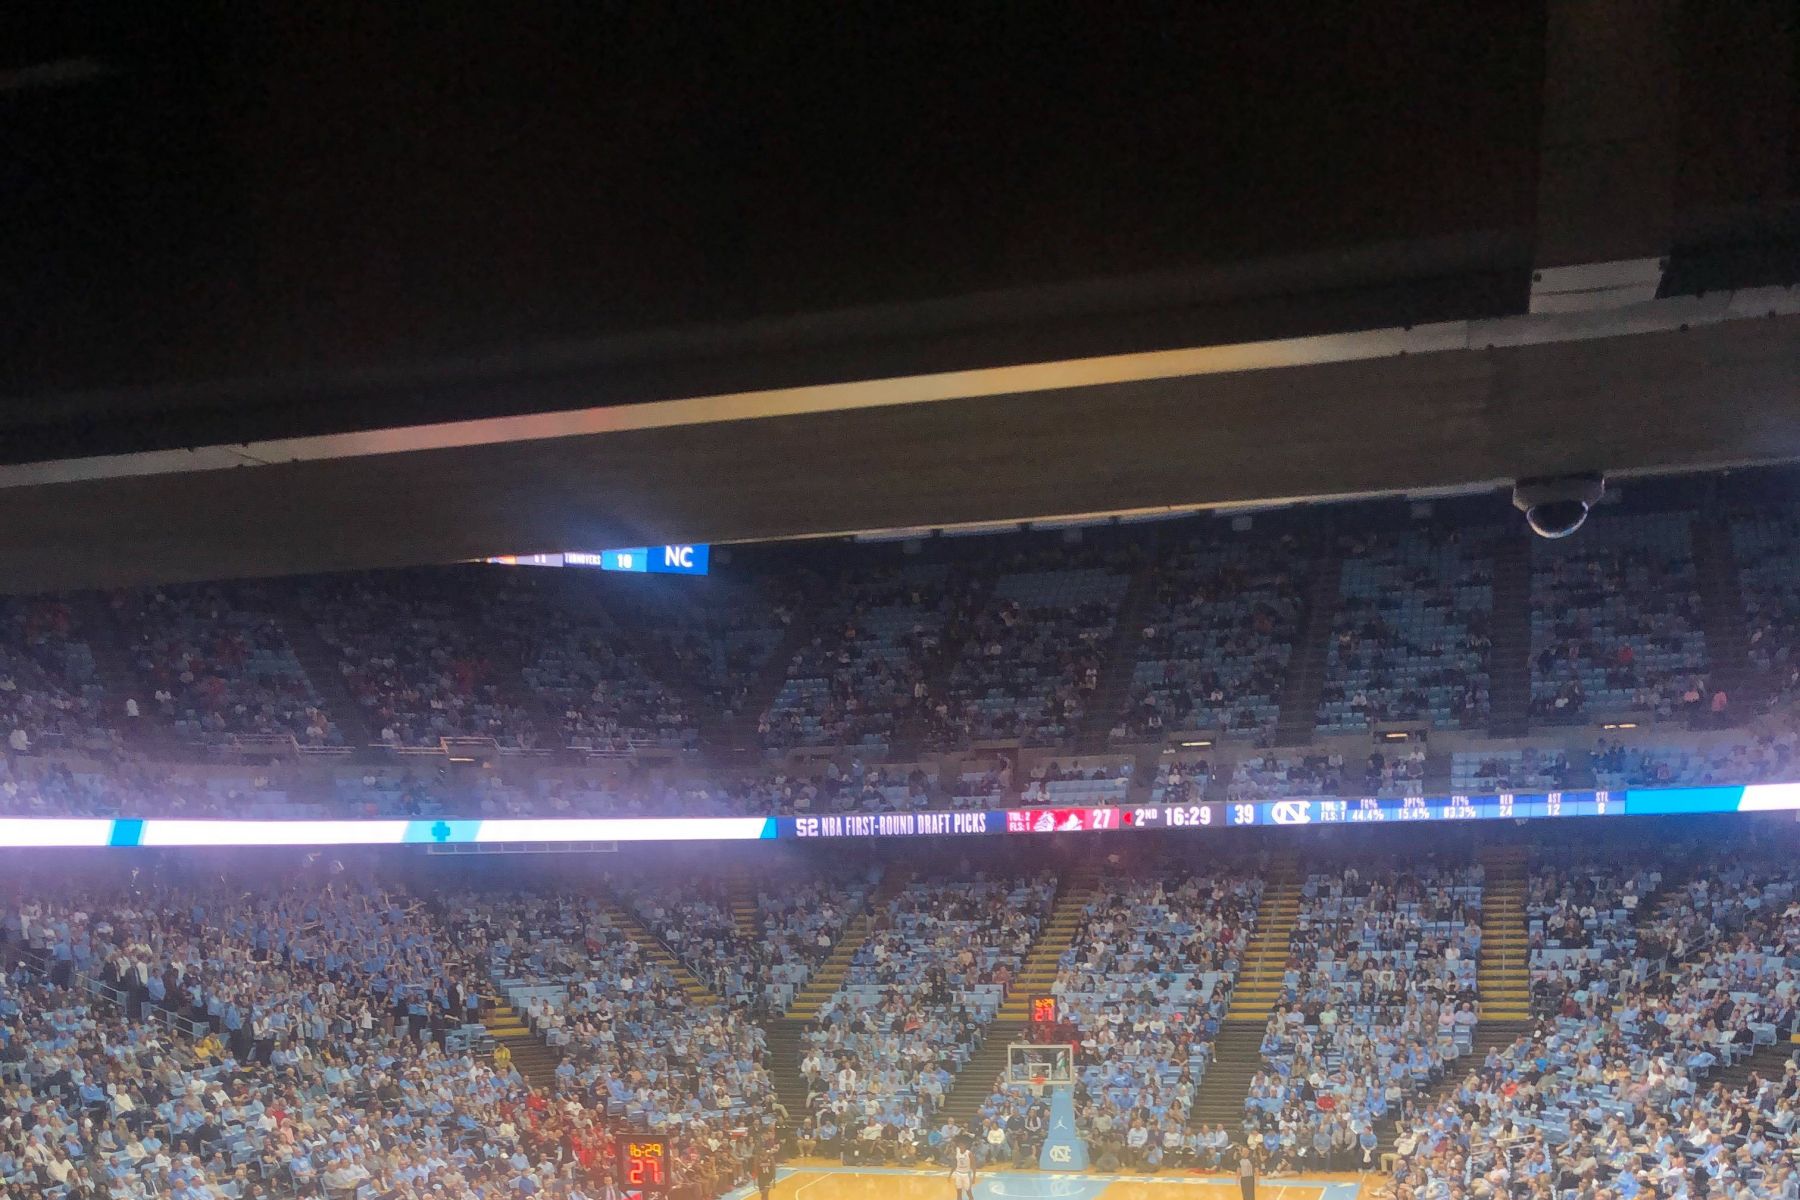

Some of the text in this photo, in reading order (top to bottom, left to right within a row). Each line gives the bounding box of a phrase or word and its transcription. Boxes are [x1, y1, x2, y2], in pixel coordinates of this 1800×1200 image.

[665, 545, 693, 568] NC
[796, 812, 987, 837] 52 NBA FIRST-ROUND DRAFT PICKS
[1092, 808, 1112, 829] 27
[1135, 808, 1158, 827] 2ND
[1164, 806, 1210, 826] 16:29
[1235, 803, 1255, 825] 39
[631, 1159, 661, 1184] 27
